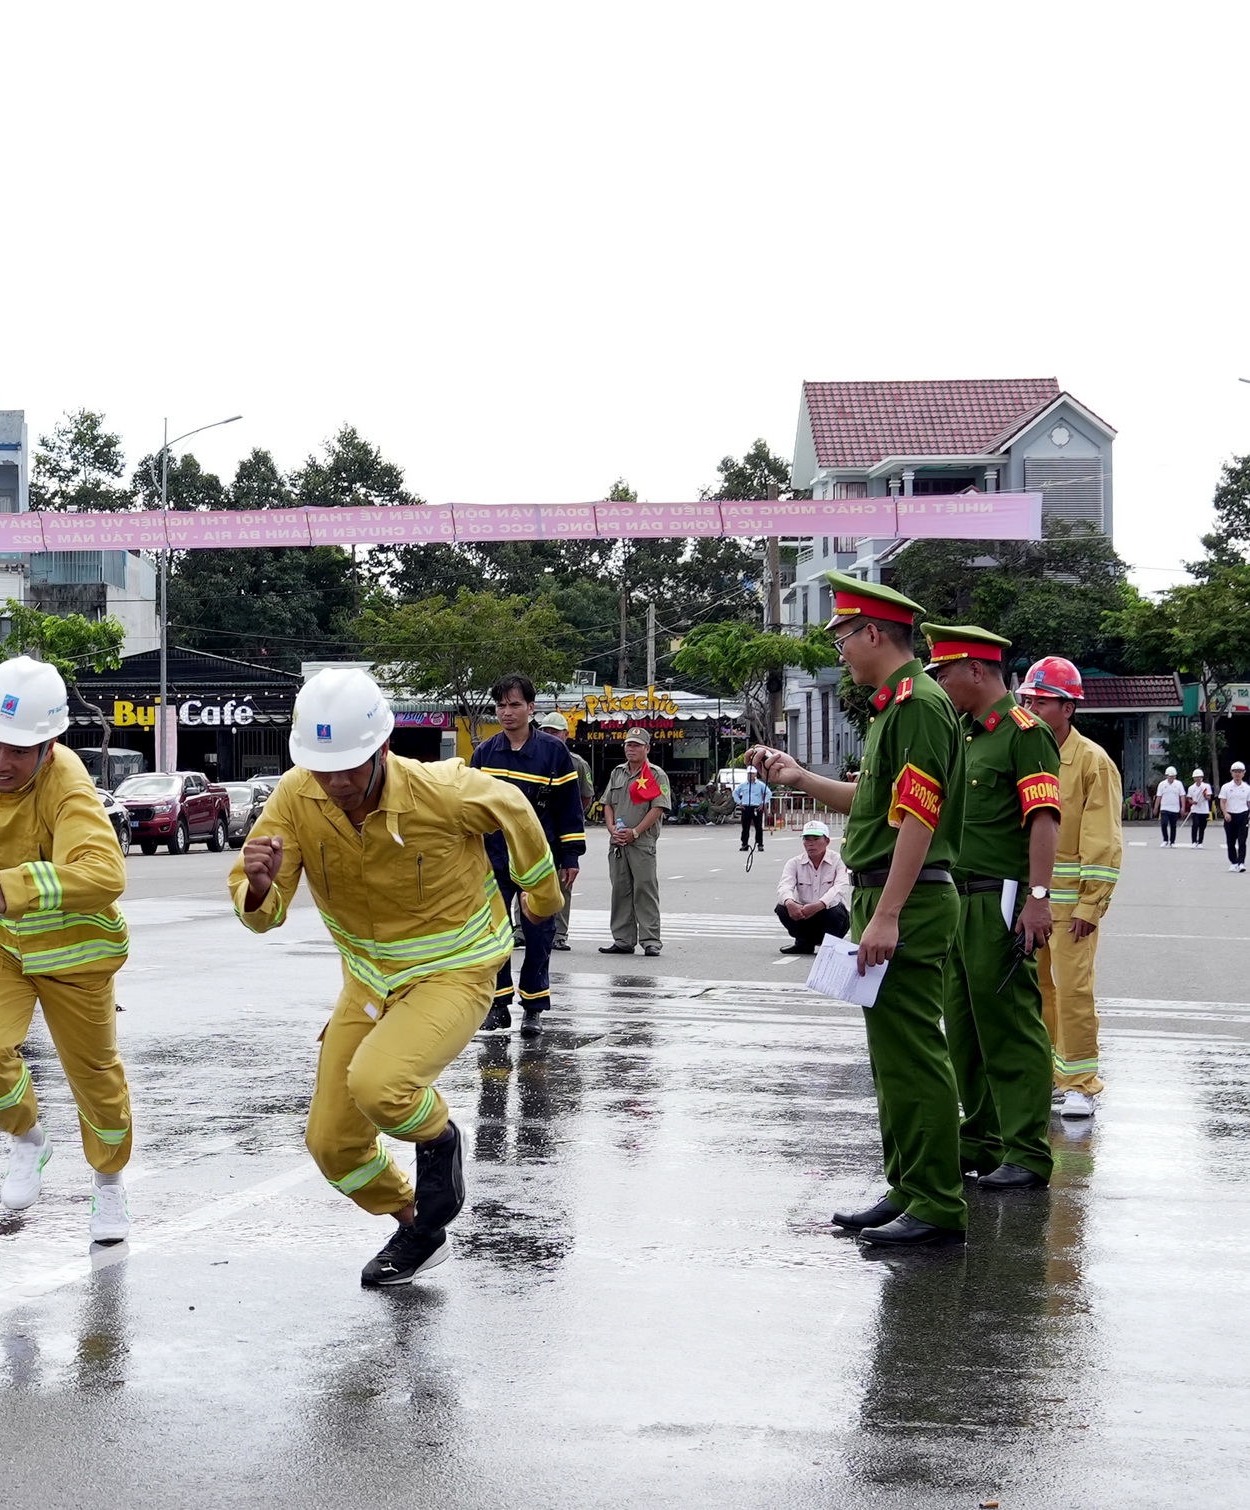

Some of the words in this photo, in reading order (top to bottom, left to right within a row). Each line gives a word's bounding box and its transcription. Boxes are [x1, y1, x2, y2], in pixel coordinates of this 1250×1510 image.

[113, 697, 161, 731] Bụ
[179, 696, 254, 726] Café
[587, 731, 605, 740] KEM
[1022, 782, 1059, 802] TRỌNG
